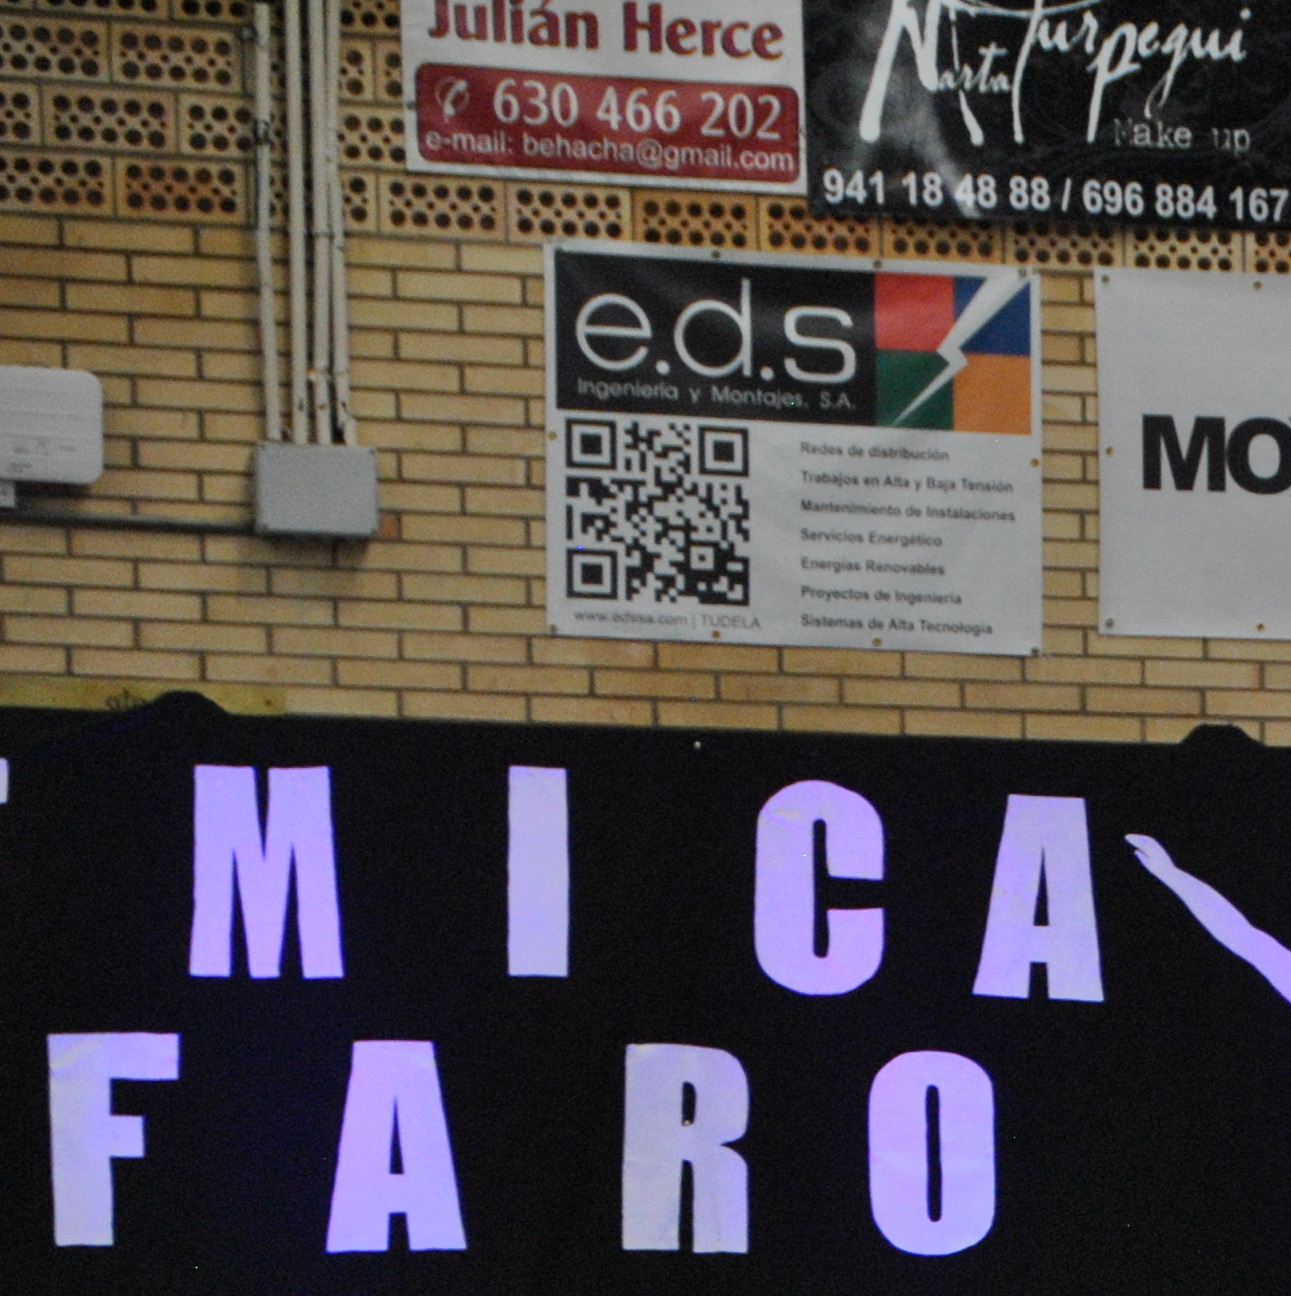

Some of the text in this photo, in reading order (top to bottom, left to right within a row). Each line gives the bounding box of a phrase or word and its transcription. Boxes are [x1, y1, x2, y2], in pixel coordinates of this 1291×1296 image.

[428, 0, 784, 61] Julián Herce
[493, 78, 782, 141] 630 466 202
[424, 130, 795, 172] e-mail: behacha@gmail.com
[823, 168, 1290, 223] 941 18 48 88 696 884 167
[575, 277, 857, 384] e.d.s
[689, 385, 701, 403] y
[800, 442, 843, 456] Redes
[848, 444, 864, 457] de
[801, 470, 859, 488] Trabajos
[863, 475, 880, 487] en
[883, 475, 910, 488] Alta
[926, 477, 956, 493] Baja
[801, 499, 1017, 522] Mantenimiento de Instalaciones
[801, 528, 864, 544] Servicios
[865, 559, 946, 576] Renovables
[801, 585, 870, 602] Proyectos
[874, 589, 890, 602] de
[701, 614, 762, 629] TUDELA
[801, 614, 864, 629] Sistemas
[868, 618, 884, 630] de
[888, 618, 914, 632] Alta
